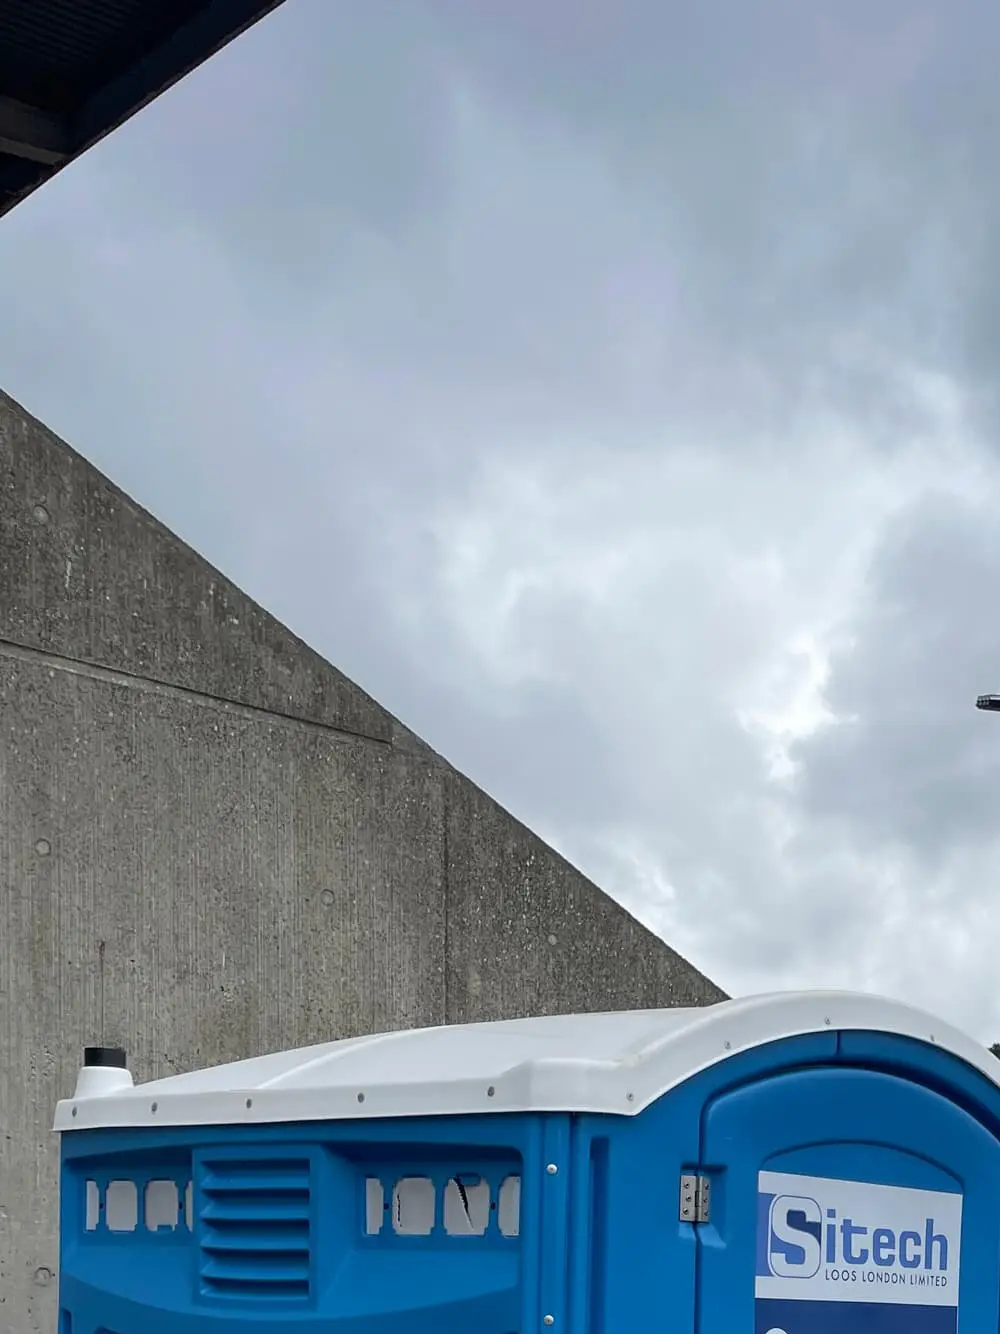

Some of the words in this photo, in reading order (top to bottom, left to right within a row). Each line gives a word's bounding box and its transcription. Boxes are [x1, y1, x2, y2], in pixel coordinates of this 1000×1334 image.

[768, 1194, 949, 1280] Sitech
[825, 1268, 857, 1283] LOOS
[862, 1270, 906, 1286] LONDON
[910, 1274, 948, 1288] LIMITED
